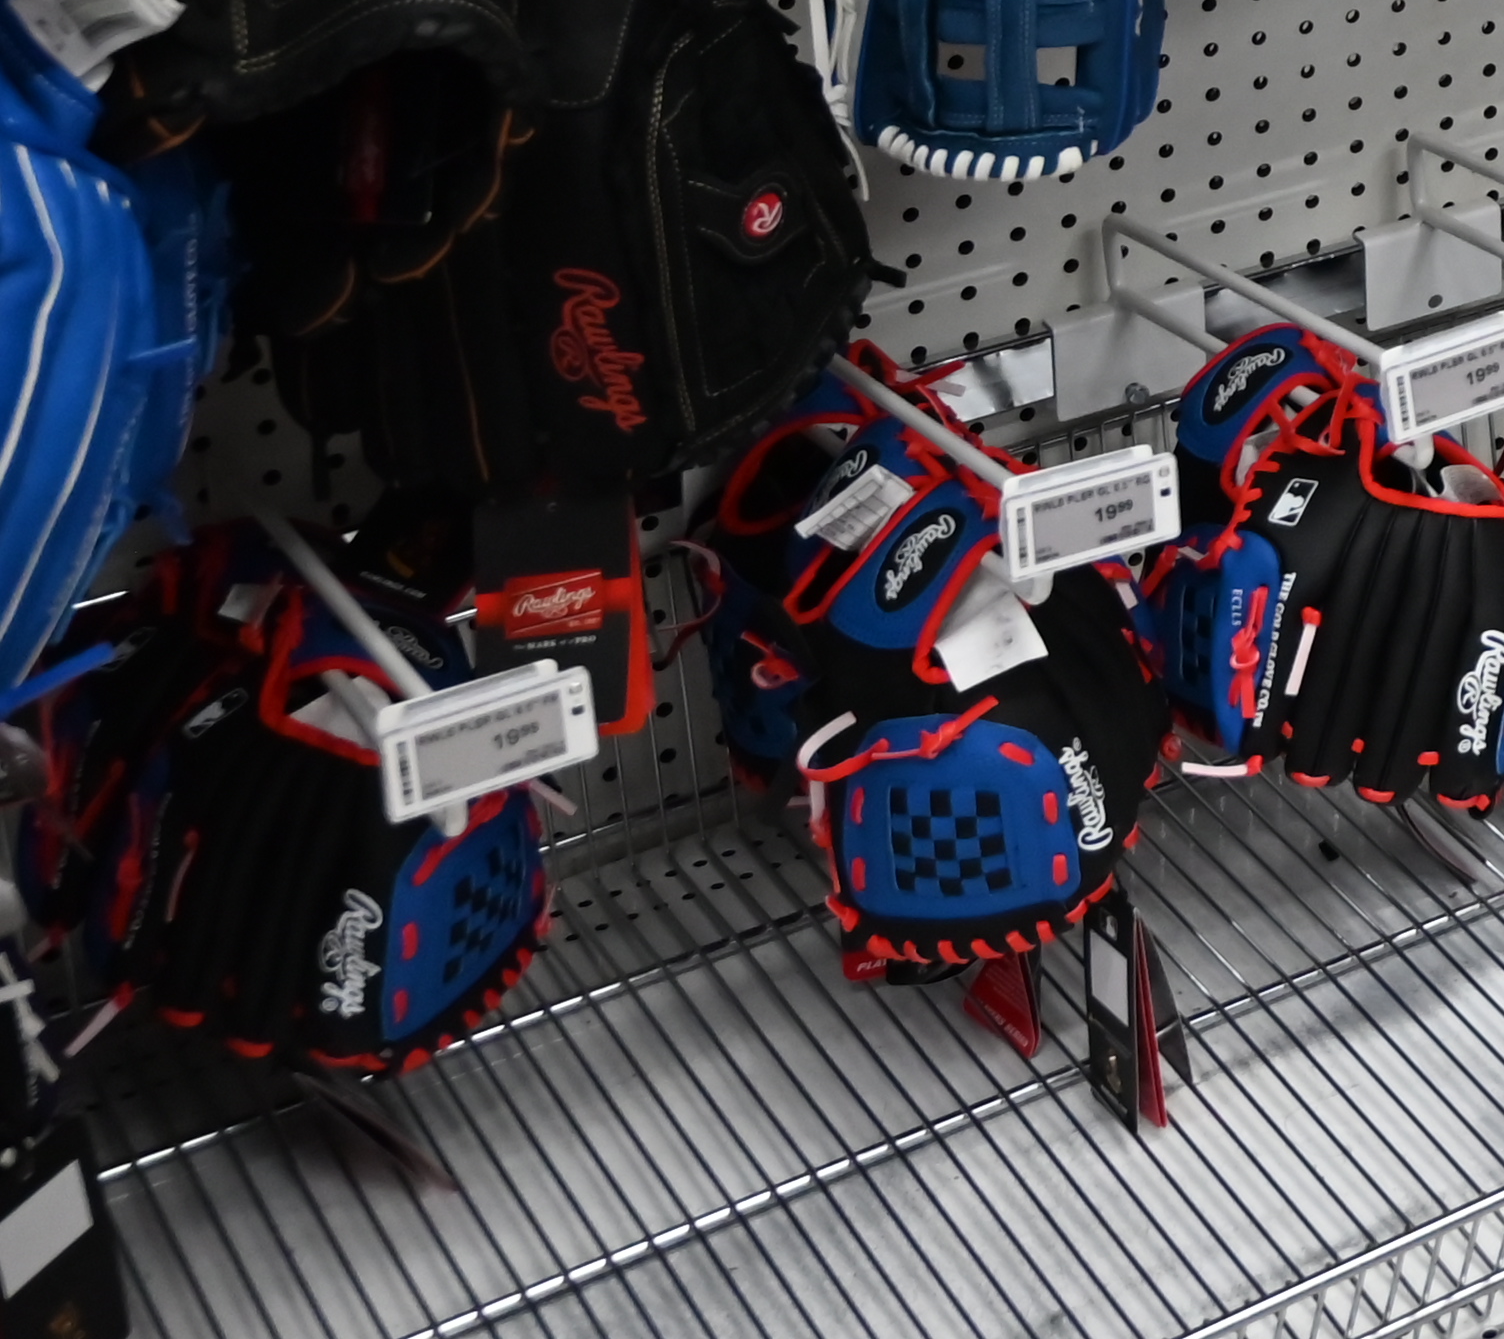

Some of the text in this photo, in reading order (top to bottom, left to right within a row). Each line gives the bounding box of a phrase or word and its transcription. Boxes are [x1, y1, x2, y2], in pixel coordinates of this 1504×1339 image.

[1263, 603, 1287, 688] GOLD GLOVE
[1058, 744, 1114, 853] Rawlings
